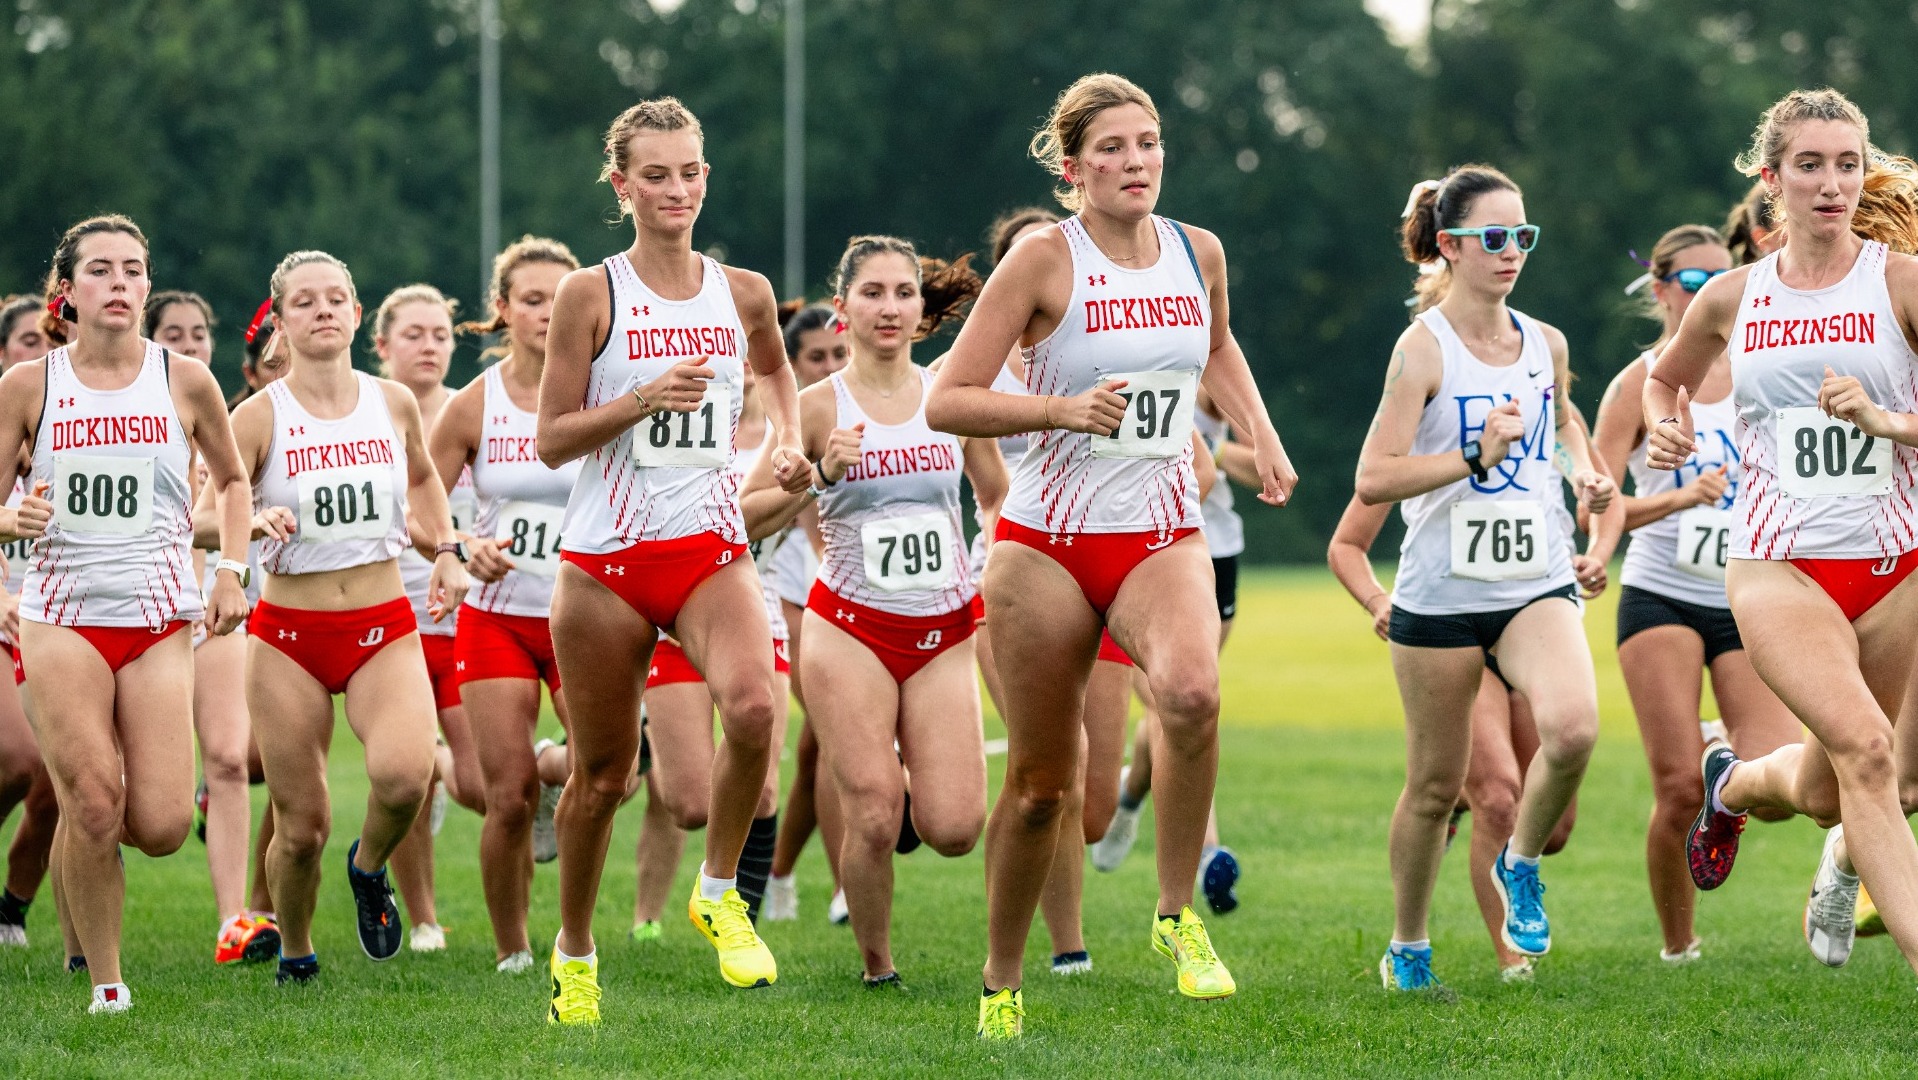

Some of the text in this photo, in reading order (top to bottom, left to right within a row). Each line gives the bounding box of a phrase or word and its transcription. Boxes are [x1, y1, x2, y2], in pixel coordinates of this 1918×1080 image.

[1085, 295, 1204, 333] DICKINSON
[1744, 312, 1875, 354] DICKINSON
[627, 327, 737, 361] DICKINSON
[52, 416, 168, 451] DICKINSON
[649, 402, 716, 448] 811
[1109, 389, 1180, 439] 797
[286, 439, 394, 477] DICKINSON
[488, 437, 537, 463] DICKI
[846, 444, 955, 482] DICKINSON
[1794, 425, 1877, 478] 802
[68, 472, 138, 518] 808
[314, 481, 380, 527] 801
[878, 530, 942, 577] 799
[1467, 519, 1534, 563] 765
